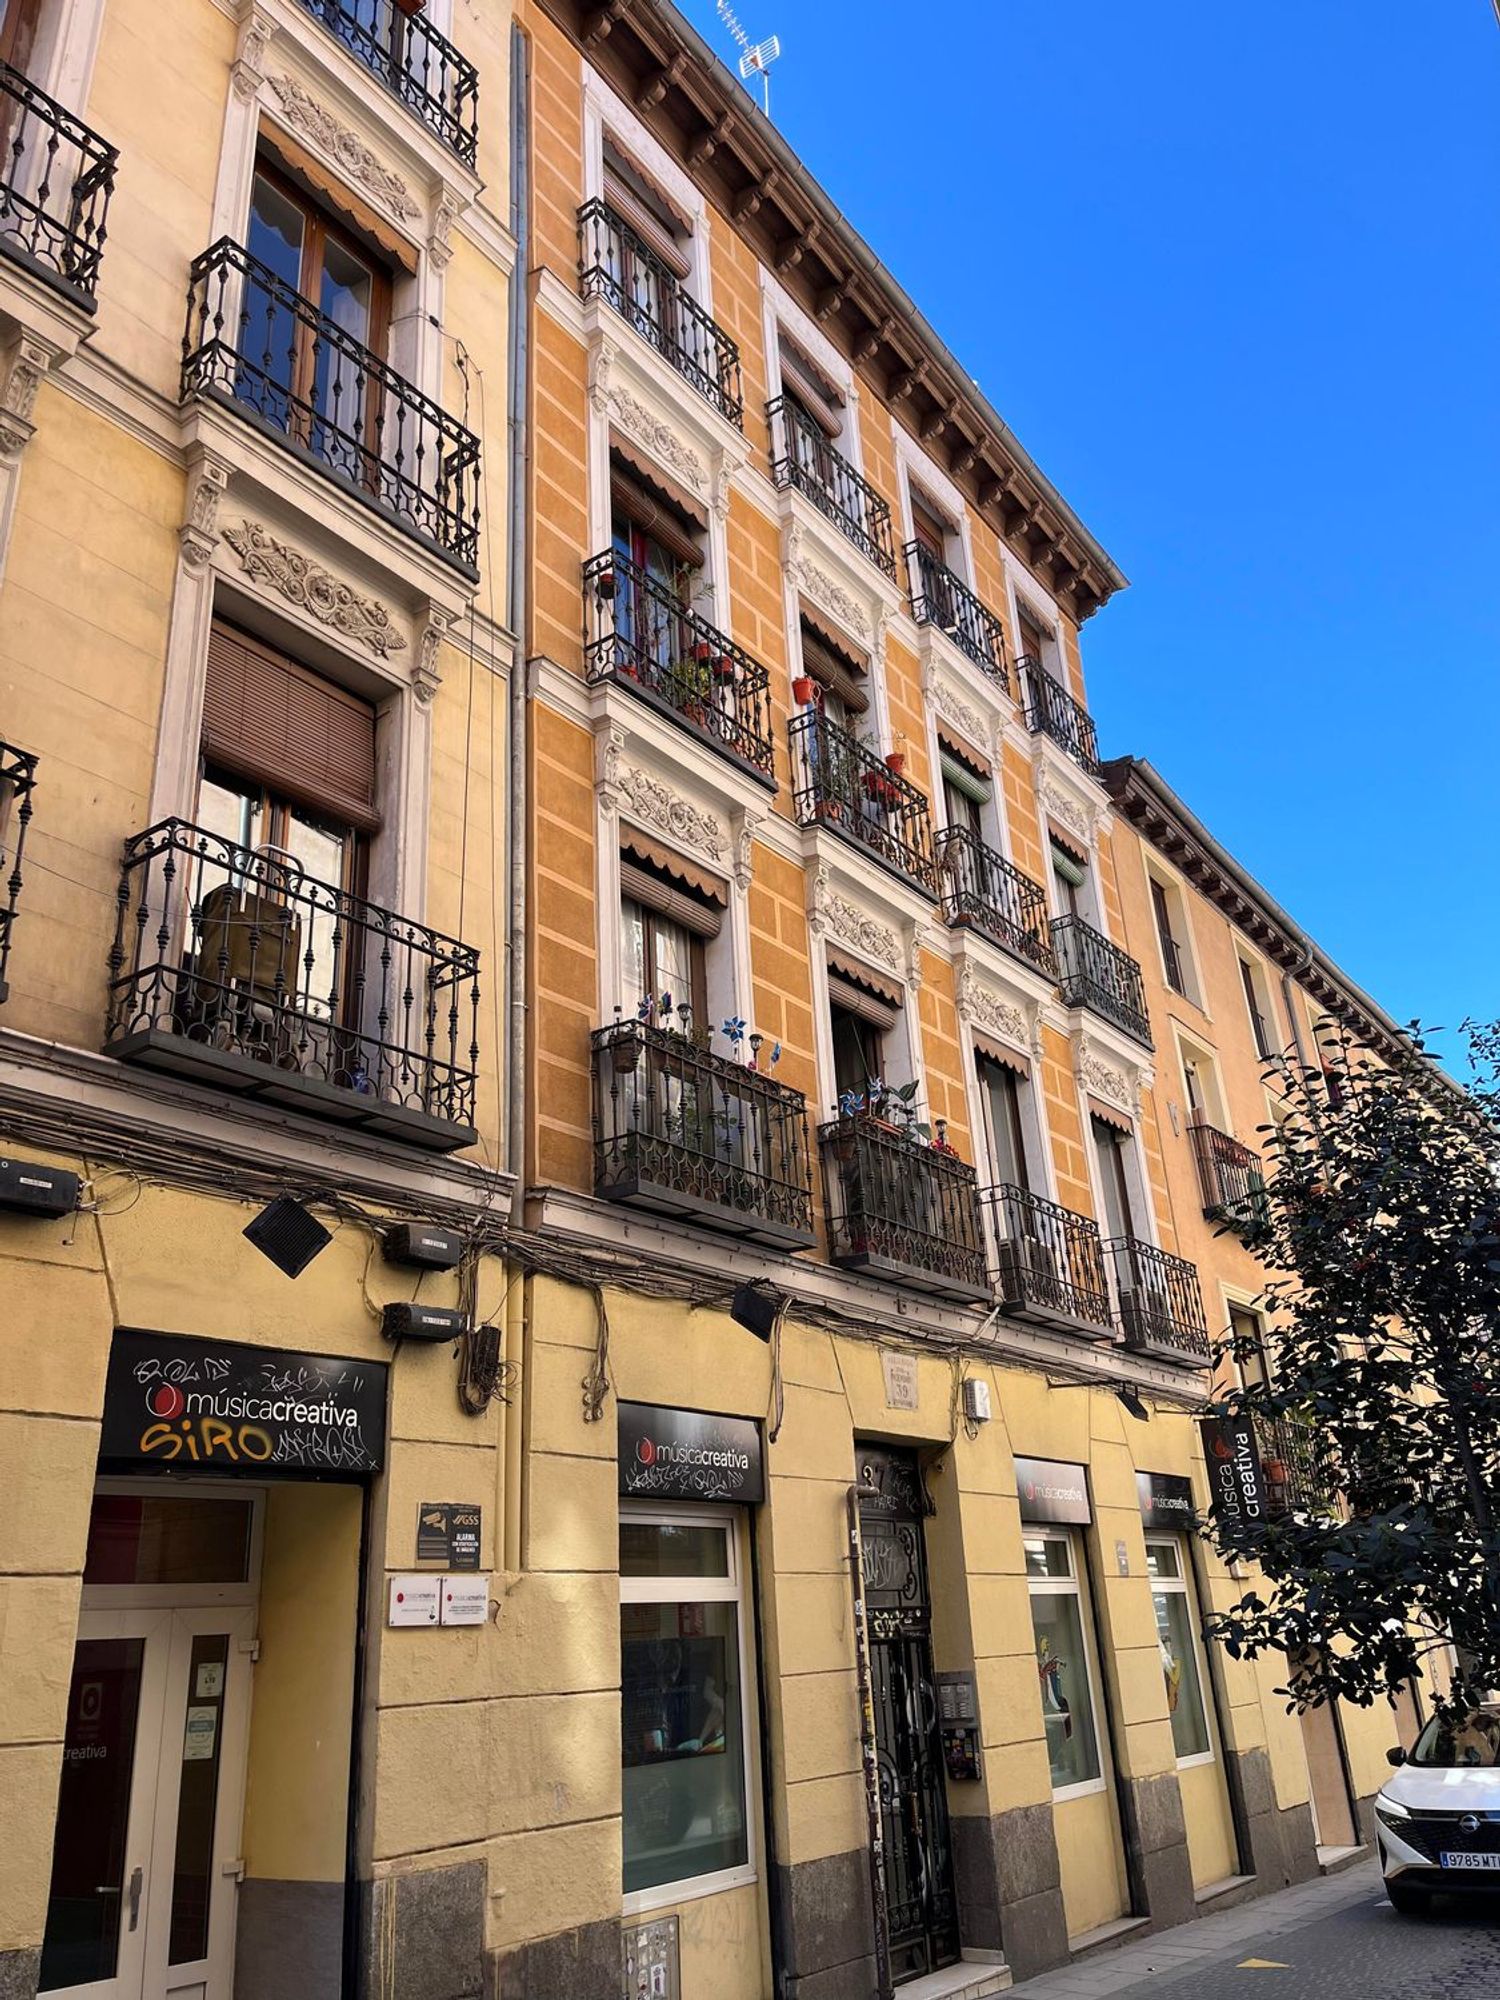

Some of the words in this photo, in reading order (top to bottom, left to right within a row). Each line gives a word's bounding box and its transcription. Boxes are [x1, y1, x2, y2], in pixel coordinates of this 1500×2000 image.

[186, 1387, 358, 1428] músicacreativa
[656, 1441, 748, 1469] músicacreativa
[1235, 1432, 1260, 1518] creativa
[1449, 1854, 1480, 1867] 9785
[1481, 1855, 1500, 1868] MT
